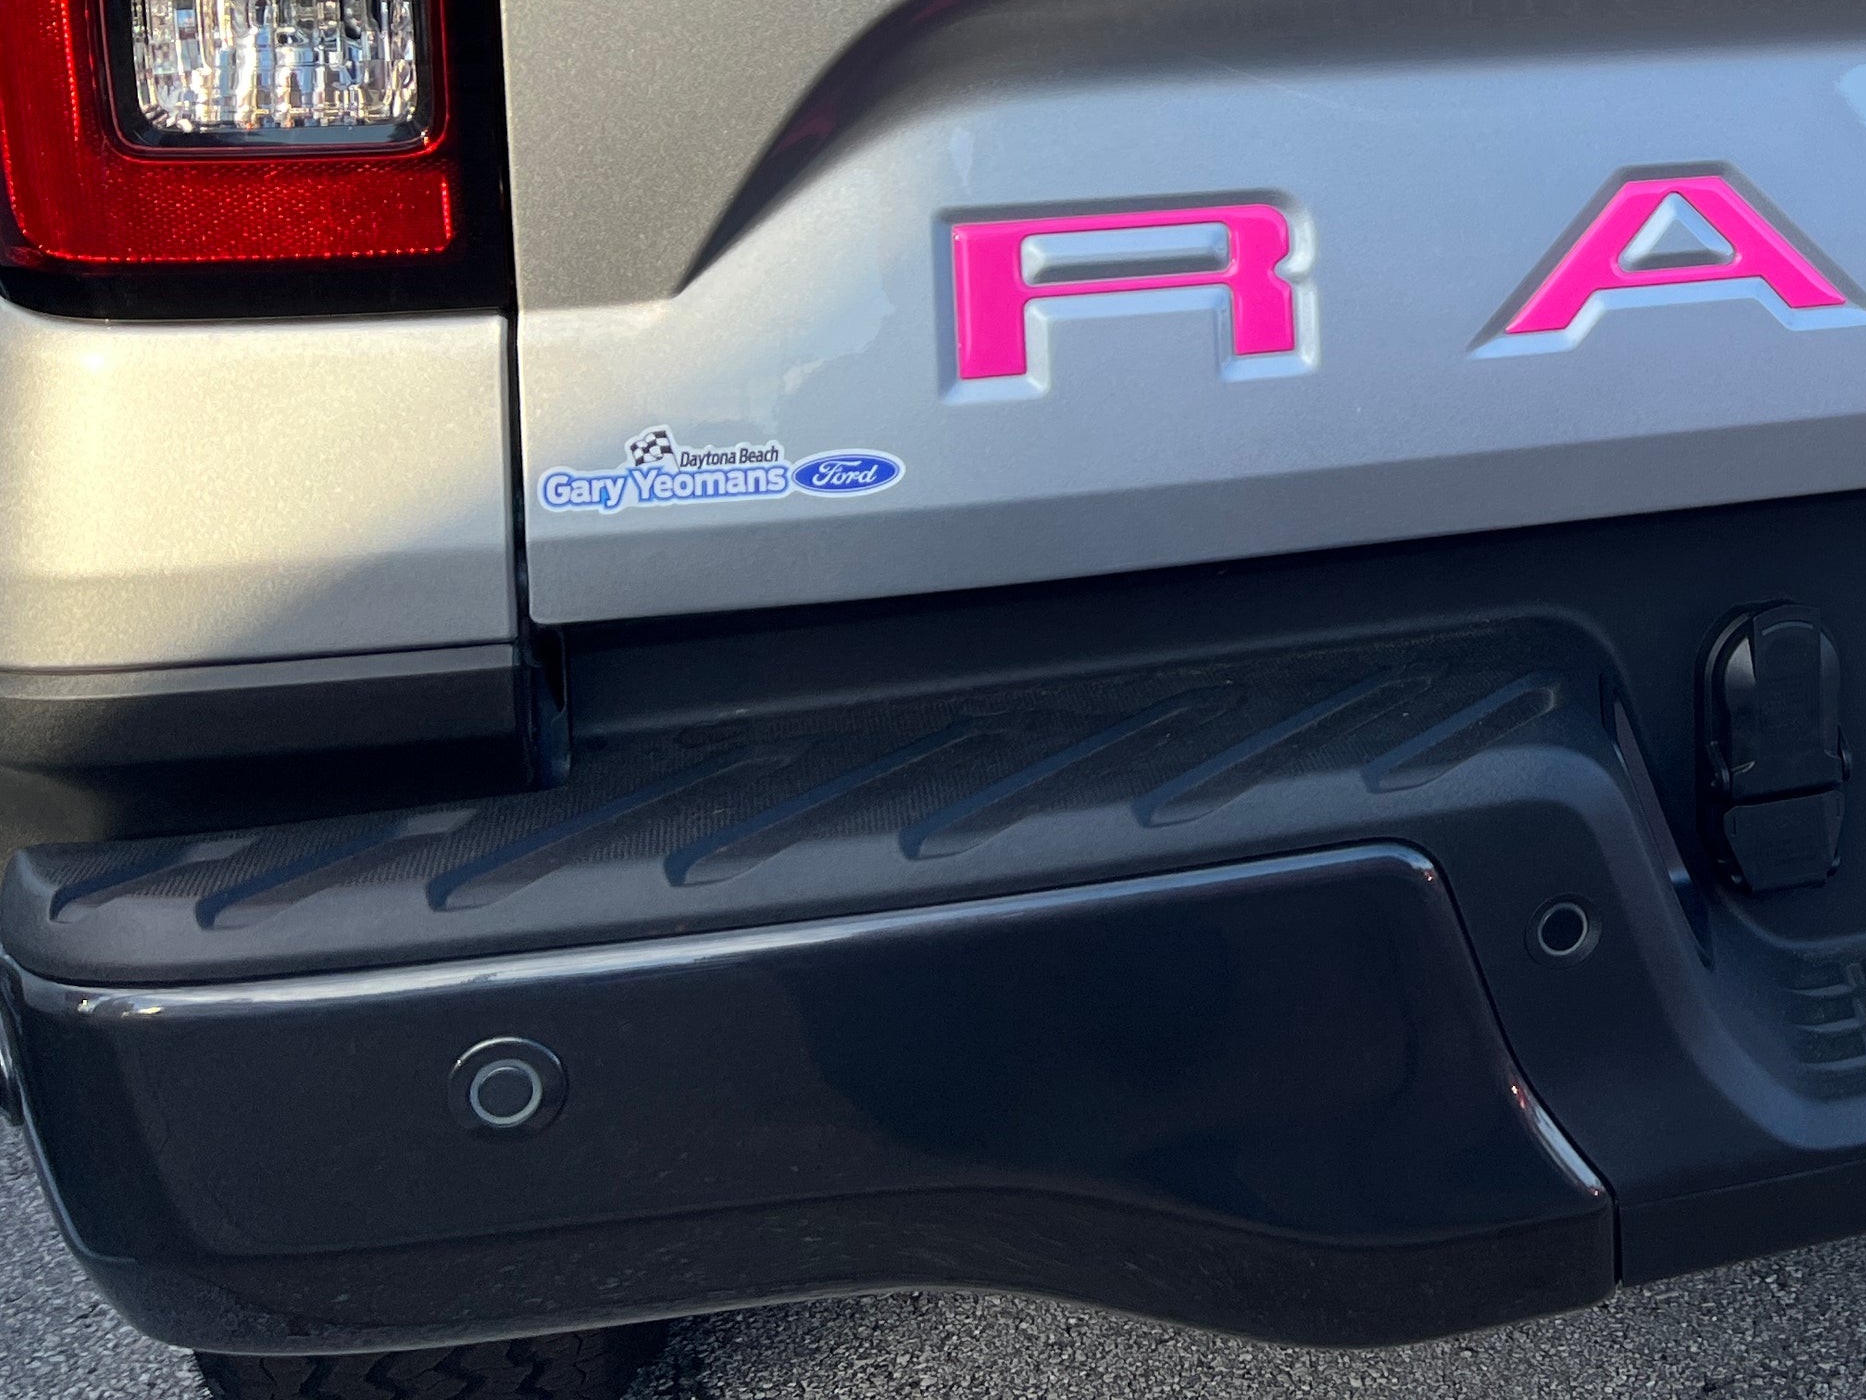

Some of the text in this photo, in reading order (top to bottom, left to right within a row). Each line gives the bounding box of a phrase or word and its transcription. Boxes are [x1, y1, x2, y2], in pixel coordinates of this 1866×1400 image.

[680, 446, 779, 469] Daytona Beach
[545, 460, 877, 508] Gary Yeomans Ford
